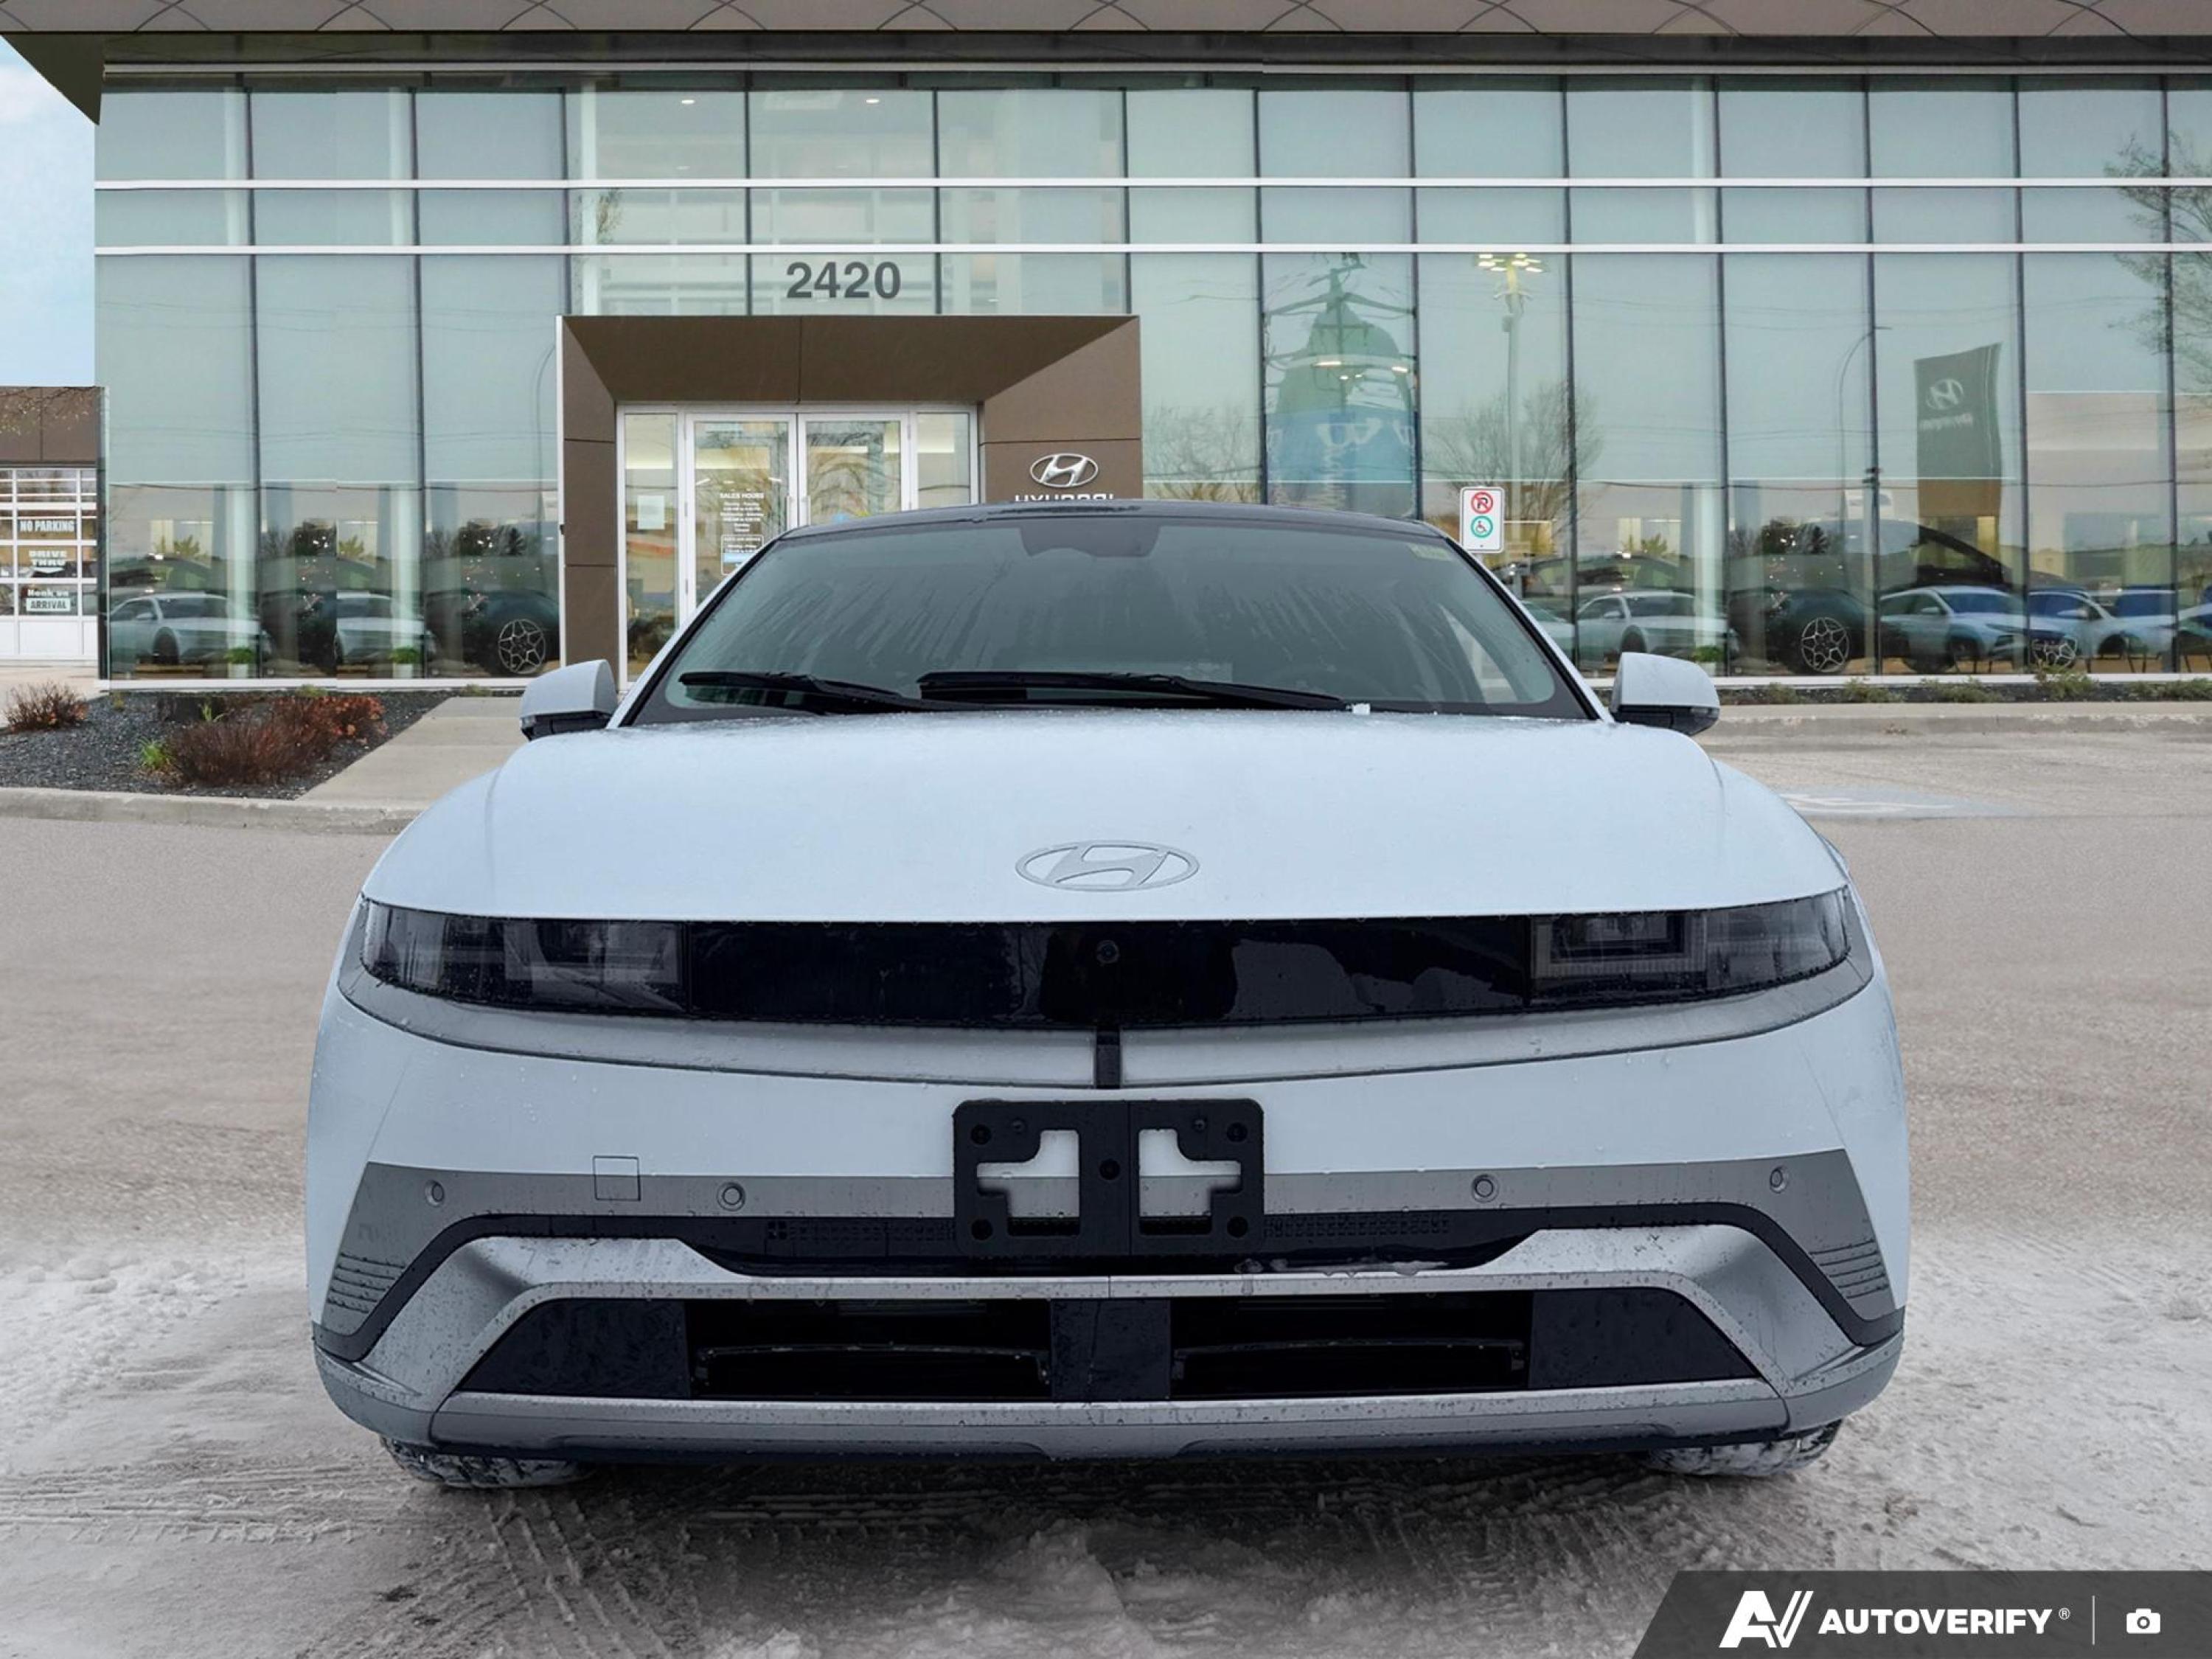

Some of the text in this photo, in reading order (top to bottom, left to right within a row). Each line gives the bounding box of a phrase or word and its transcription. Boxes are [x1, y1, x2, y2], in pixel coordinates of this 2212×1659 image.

[786, 261, 900, 299] 2420
[20, 520, 74, 532] NO PARKING
[30, 601, 67, 609] ARRIVAL
